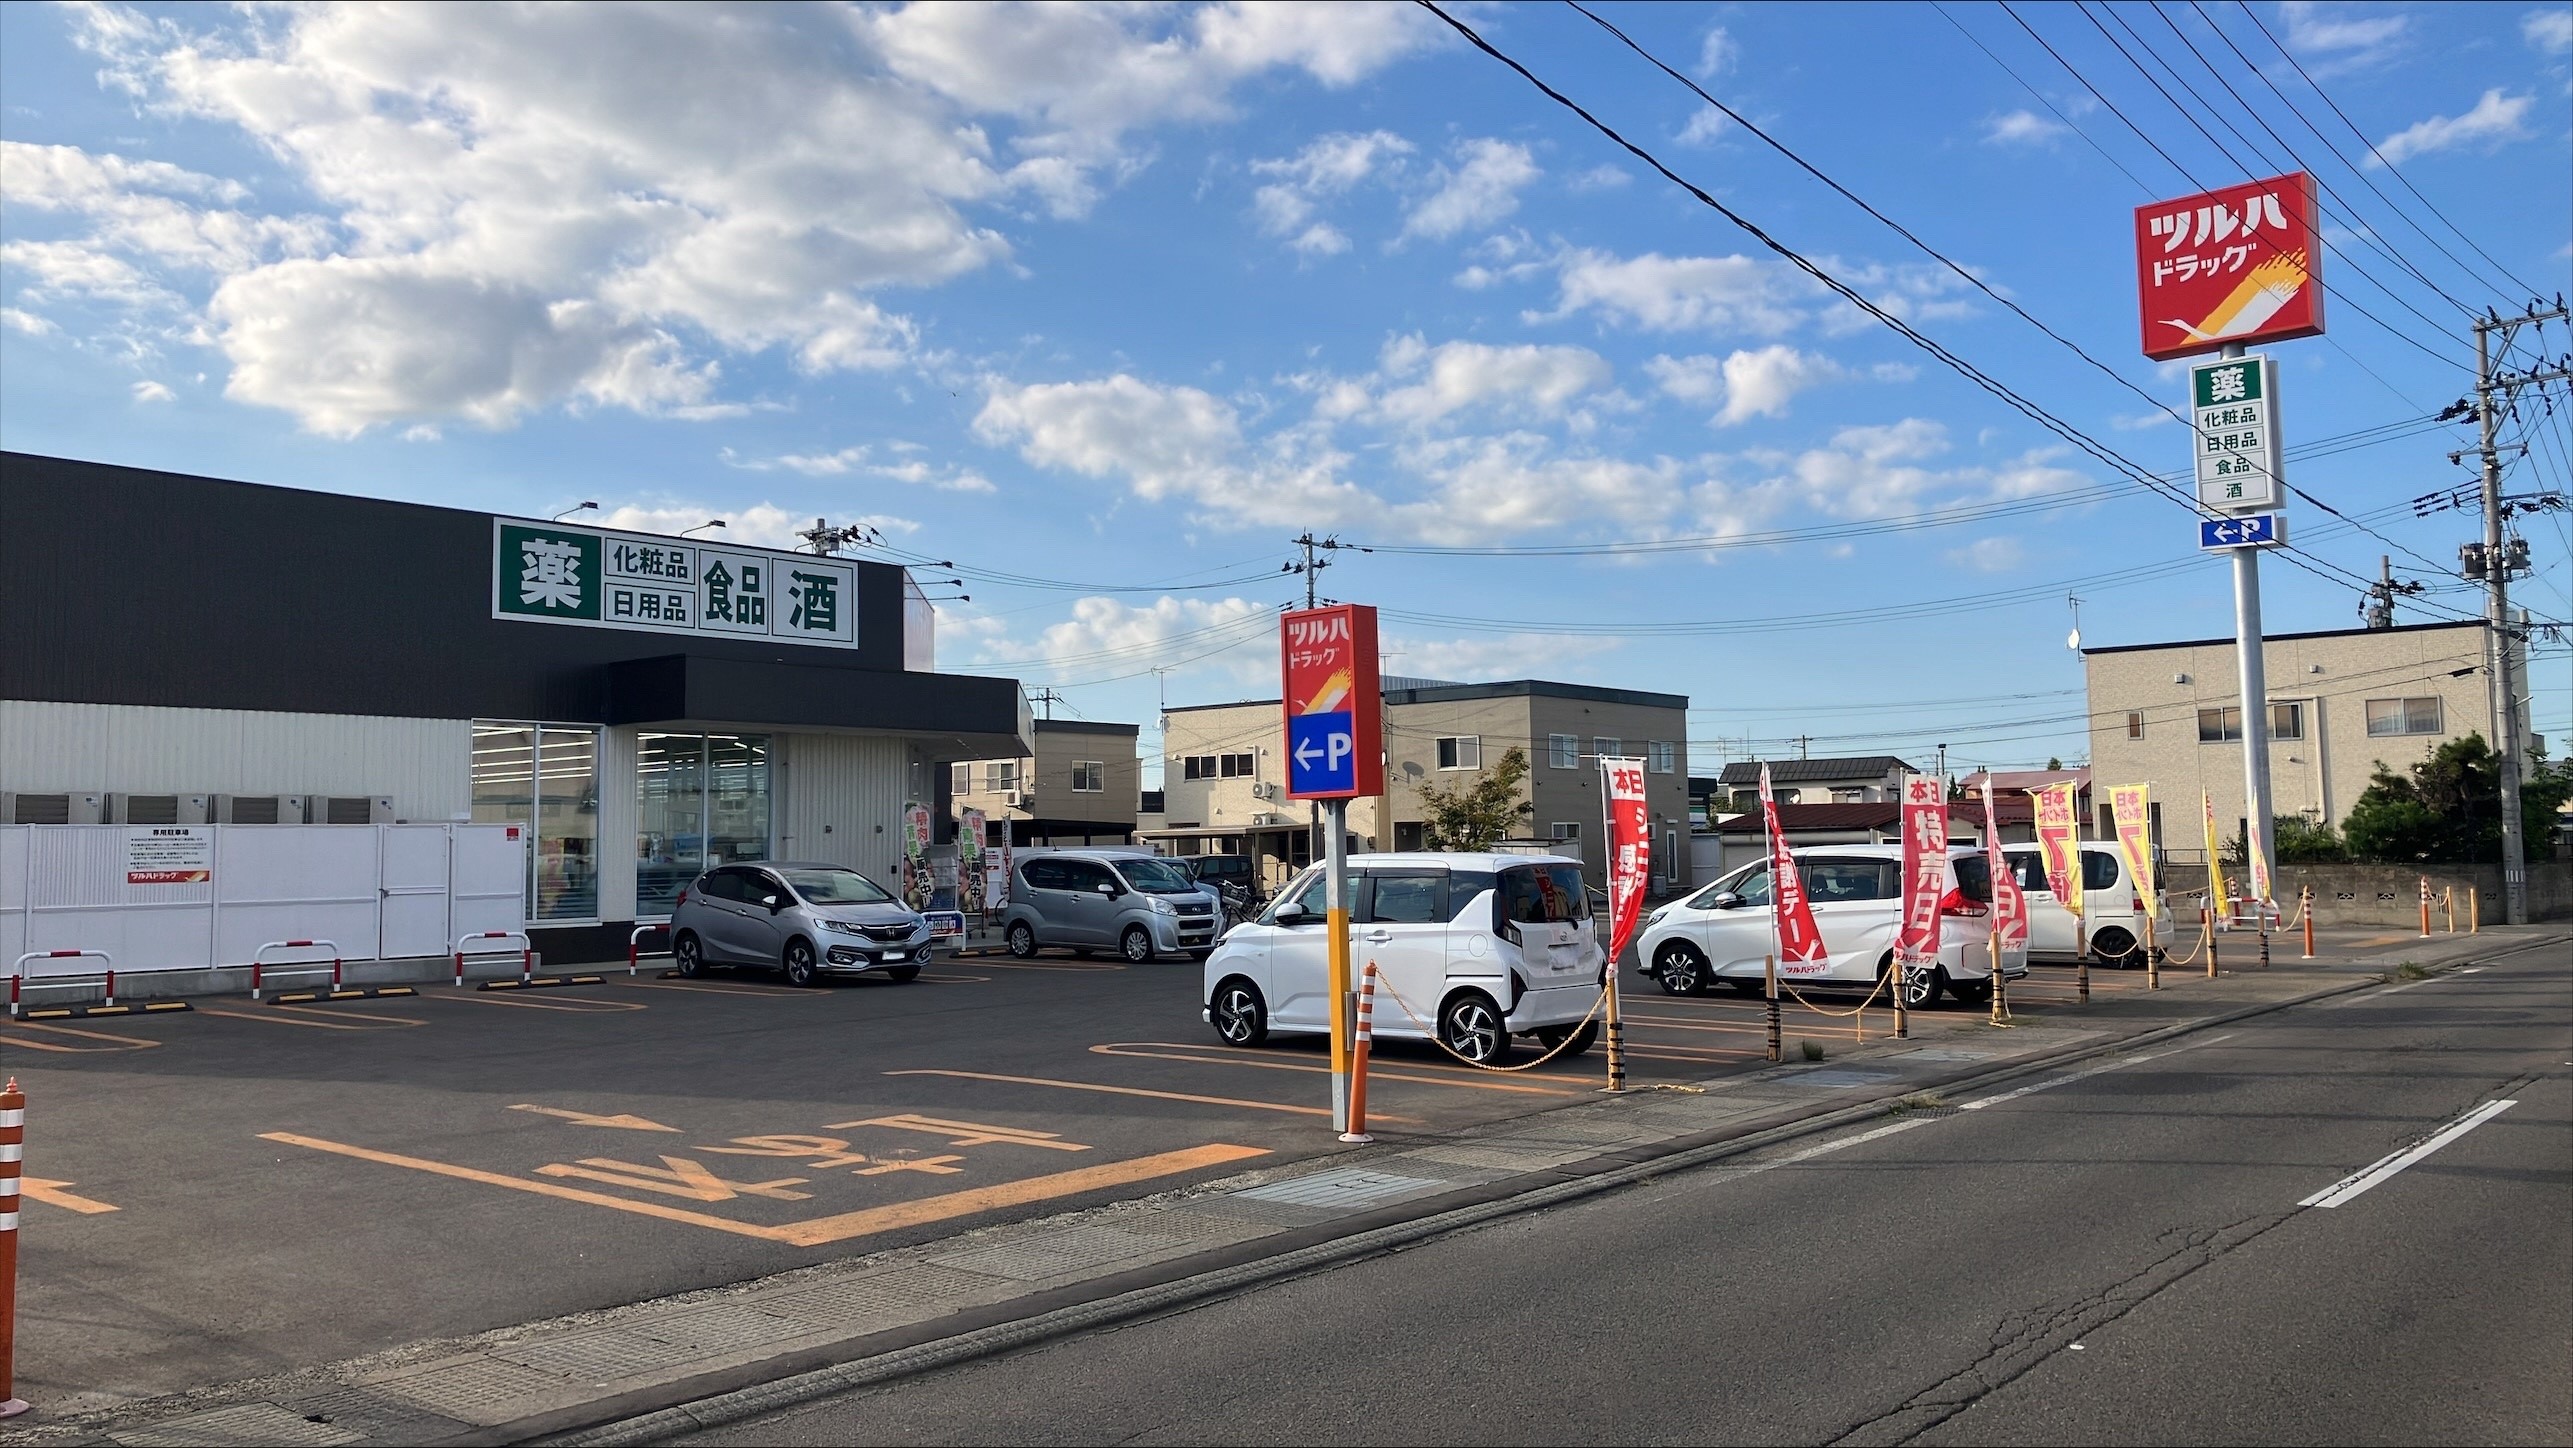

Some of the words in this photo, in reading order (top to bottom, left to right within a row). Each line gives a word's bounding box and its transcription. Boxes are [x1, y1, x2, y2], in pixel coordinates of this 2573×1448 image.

[2150, 192, 2287, 253] ツルハ
[2153, 243, 2257, 287] ドラッグ
[2210, 366, 2246, 402] 薬
[2204, 407, 2257, 428] 化粧品
[2207, 431, 2257, 452] 日用品
[2216, 458, 2250, 475] 食品
[2226, 483, 2242, 498] 酒
[2240, 519, 2261, 542] P
[520, 537, 582, 609] 薬
[613, 544, 689, 579] 化粧品
[613, 590, 687, 622] 日用品
[703, 560, 765, 625] 食品
[788, 569, 838, 632] 酒
[1288, 617, 1350, 647] ツルハ
[1289, 647, 1340, 669] ドラッグ
[1327, 732, 1352, 771] P
[1613, 768, 1644, 794] 本日
[1910, 780, 1940, 803] 本日
[1909, 810, 1945, 931] 特売日
